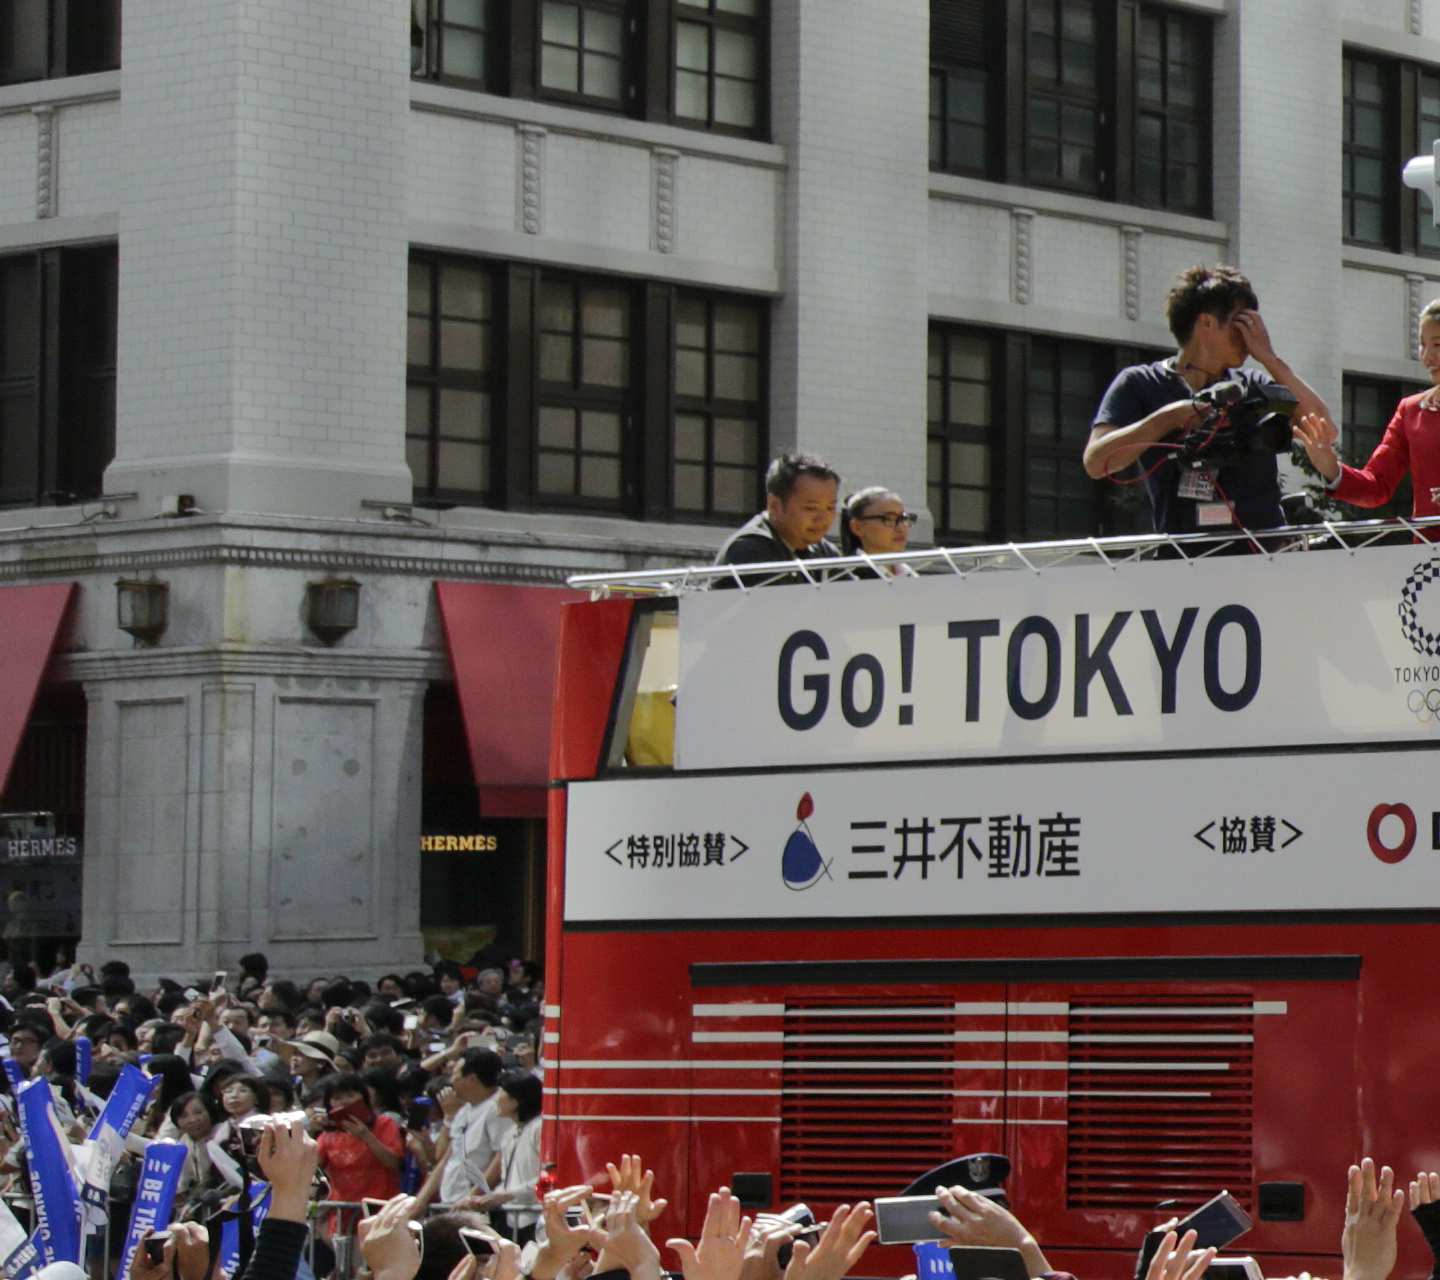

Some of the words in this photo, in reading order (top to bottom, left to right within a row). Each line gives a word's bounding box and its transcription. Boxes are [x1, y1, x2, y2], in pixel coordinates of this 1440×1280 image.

[777, 624, 914, 732] Go!
[948, 603, 1262, 723] TOKYO
[1394, 664, 1440, 683] TOKYO
[848, 811, 1082, 882] 三井不動産
[140, 1179, 163, 1203] BE
[130, 1207, 157, 1243] THE
